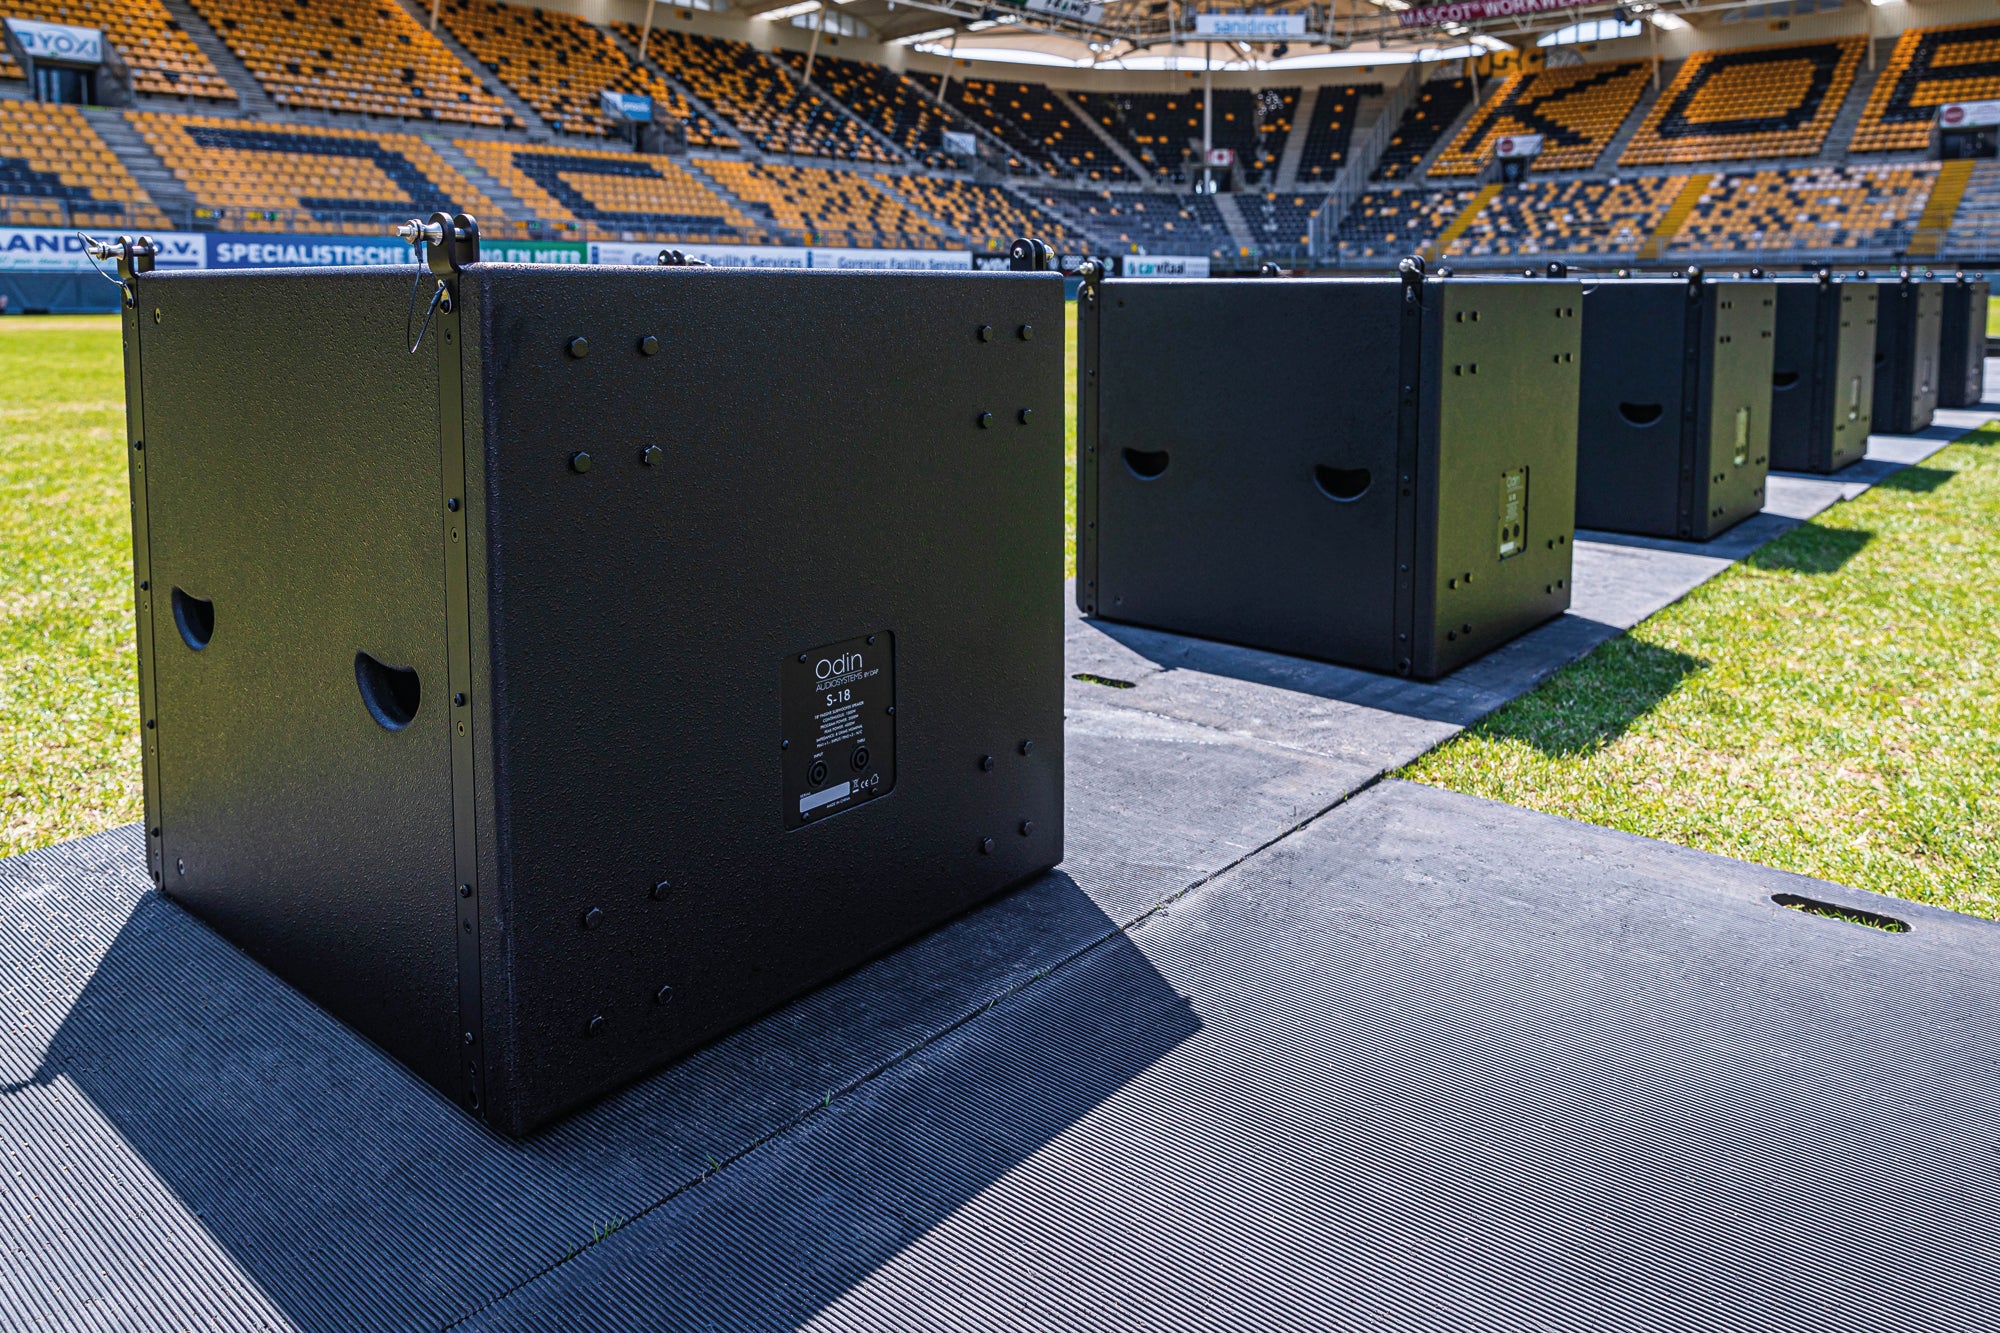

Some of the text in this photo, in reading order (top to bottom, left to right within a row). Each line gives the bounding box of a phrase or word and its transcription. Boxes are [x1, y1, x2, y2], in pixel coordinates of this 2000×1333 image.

[1214, 17, 1288, 34] sanidirect
[216, 242, 405, 263] SPECIALISTISCHE
[815, 652, 863, 679] Odin
[815, 671, 863, 692] AUDIOSYSTEMS
[826, 688, 851, 707] S-18
